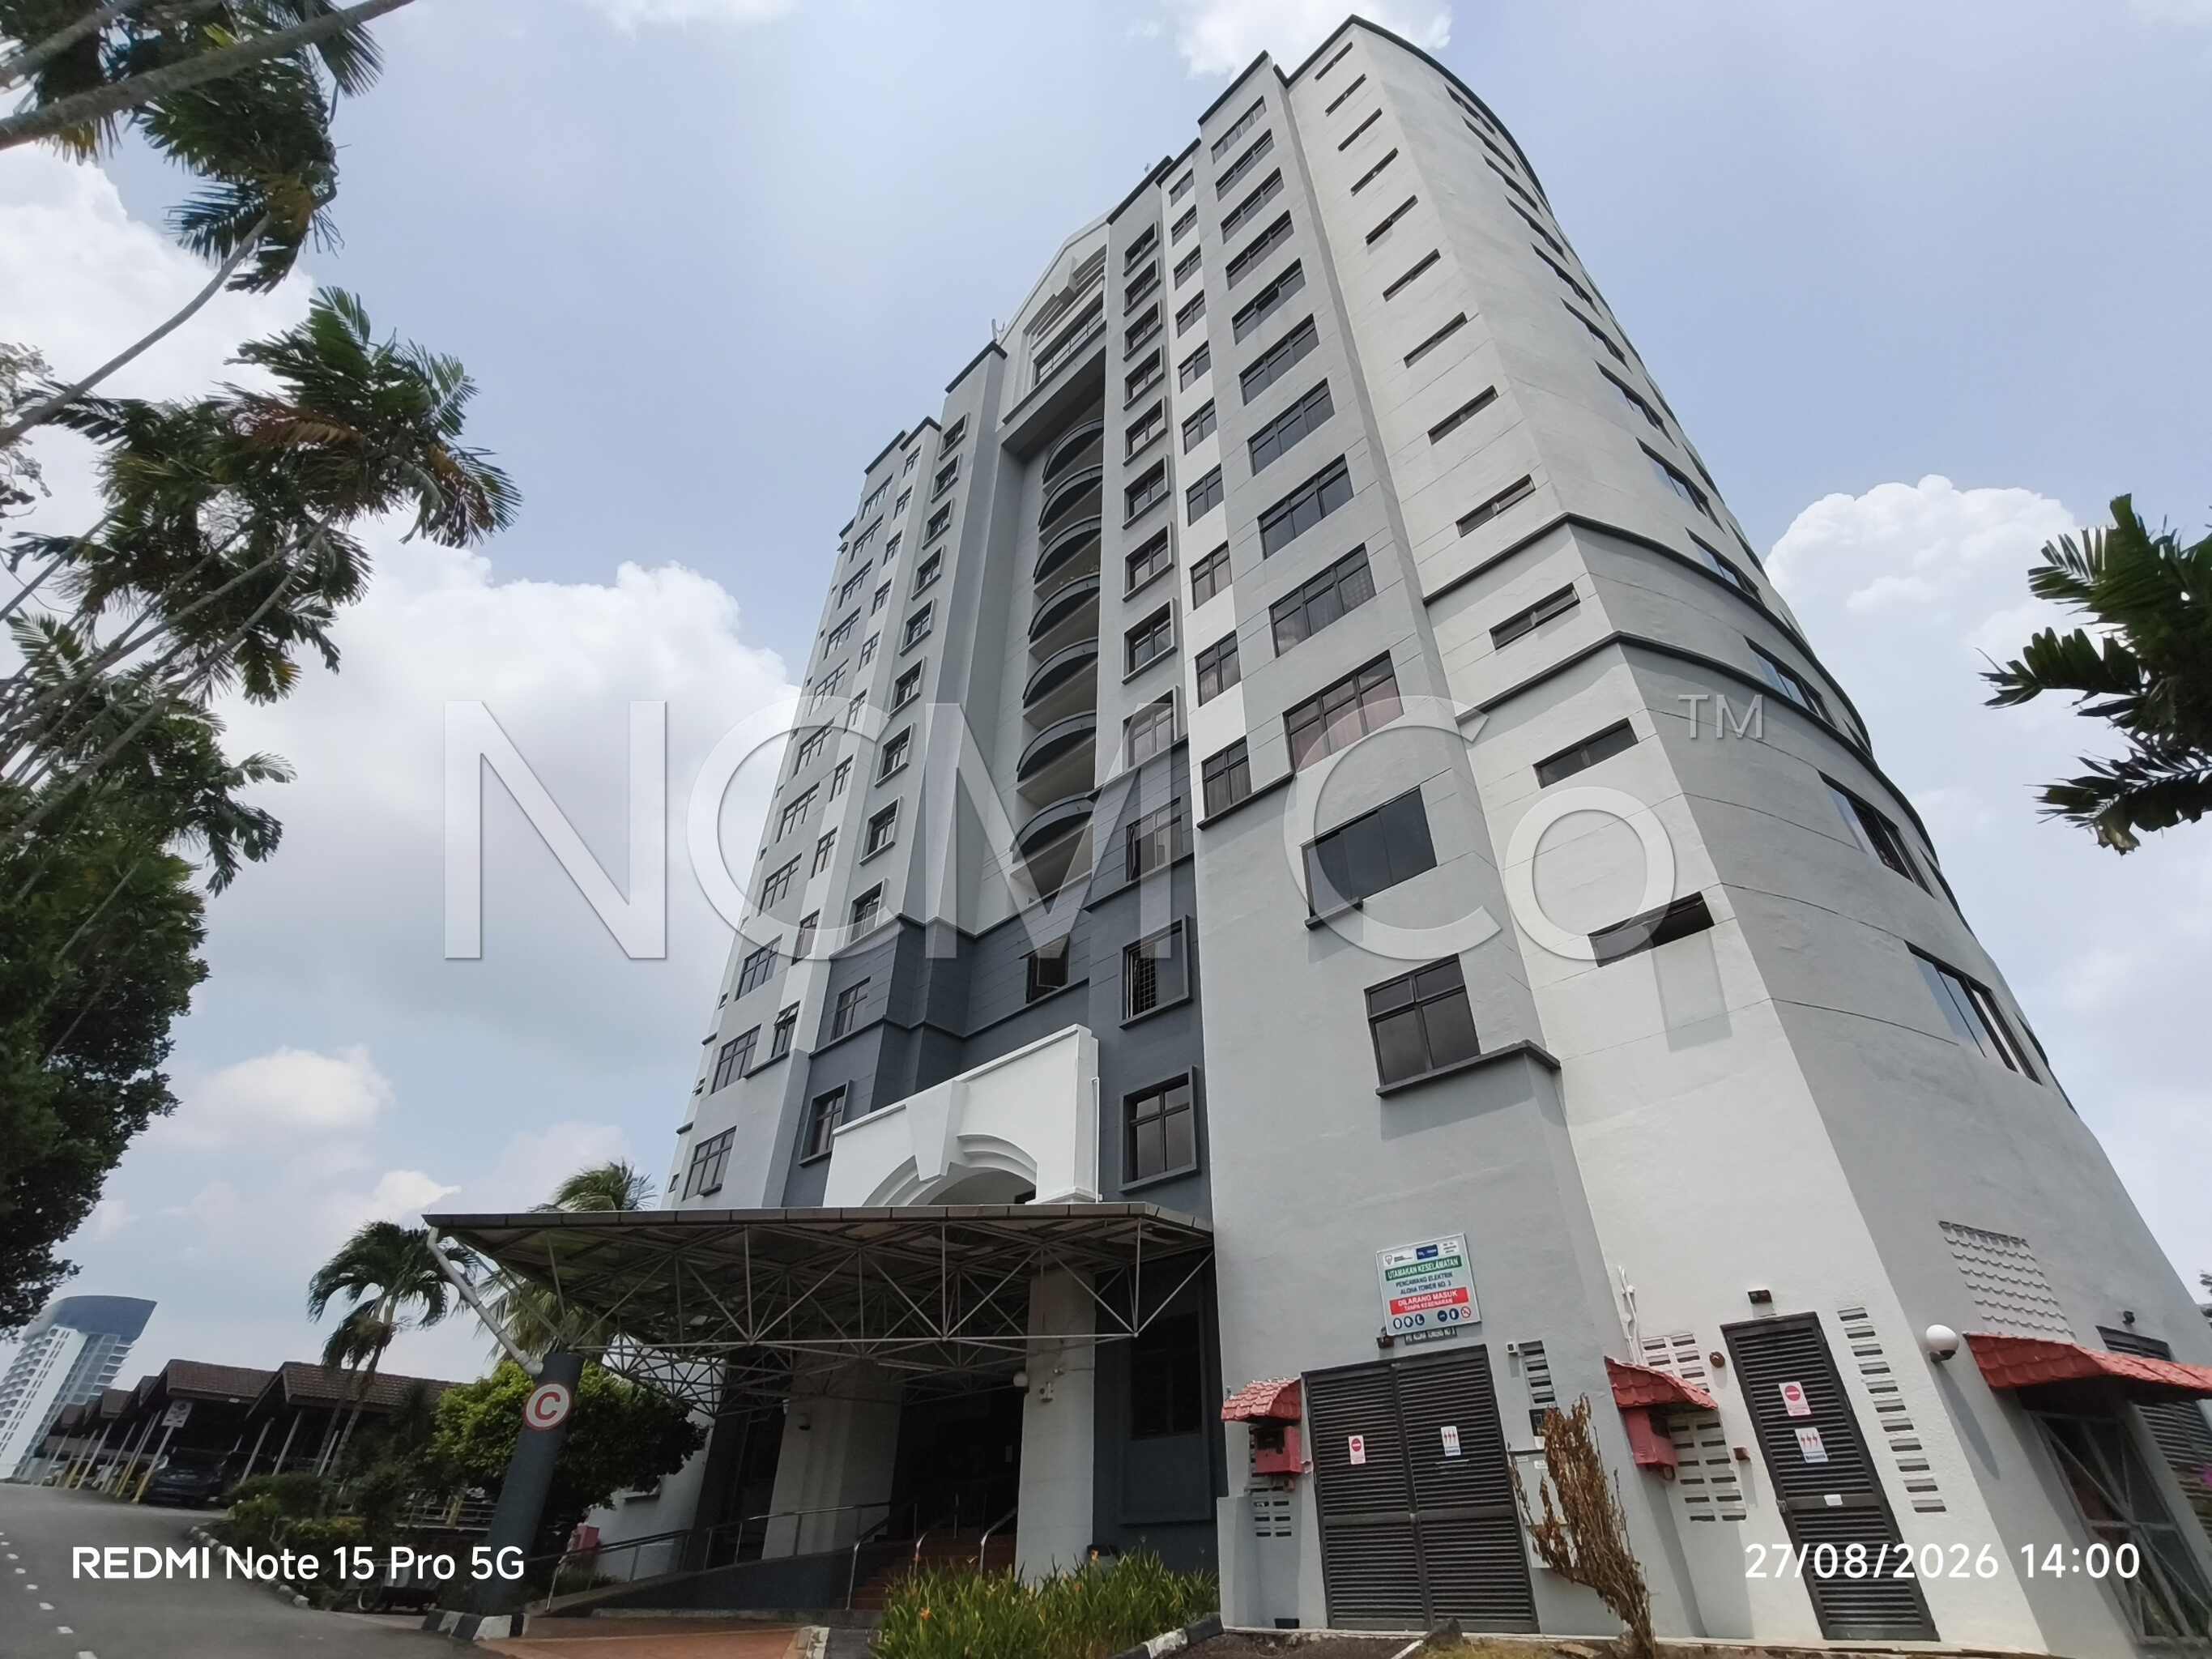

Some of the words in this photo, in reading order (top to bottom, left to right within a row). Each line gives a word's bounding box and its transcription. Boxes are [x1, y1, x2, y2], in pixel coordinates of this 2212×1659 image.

[1398, 1294, 1432, 1307] DILARANG
[1433, 1290, 1459, 1300] MASUK
[535, 1392, 560, 1420] C
